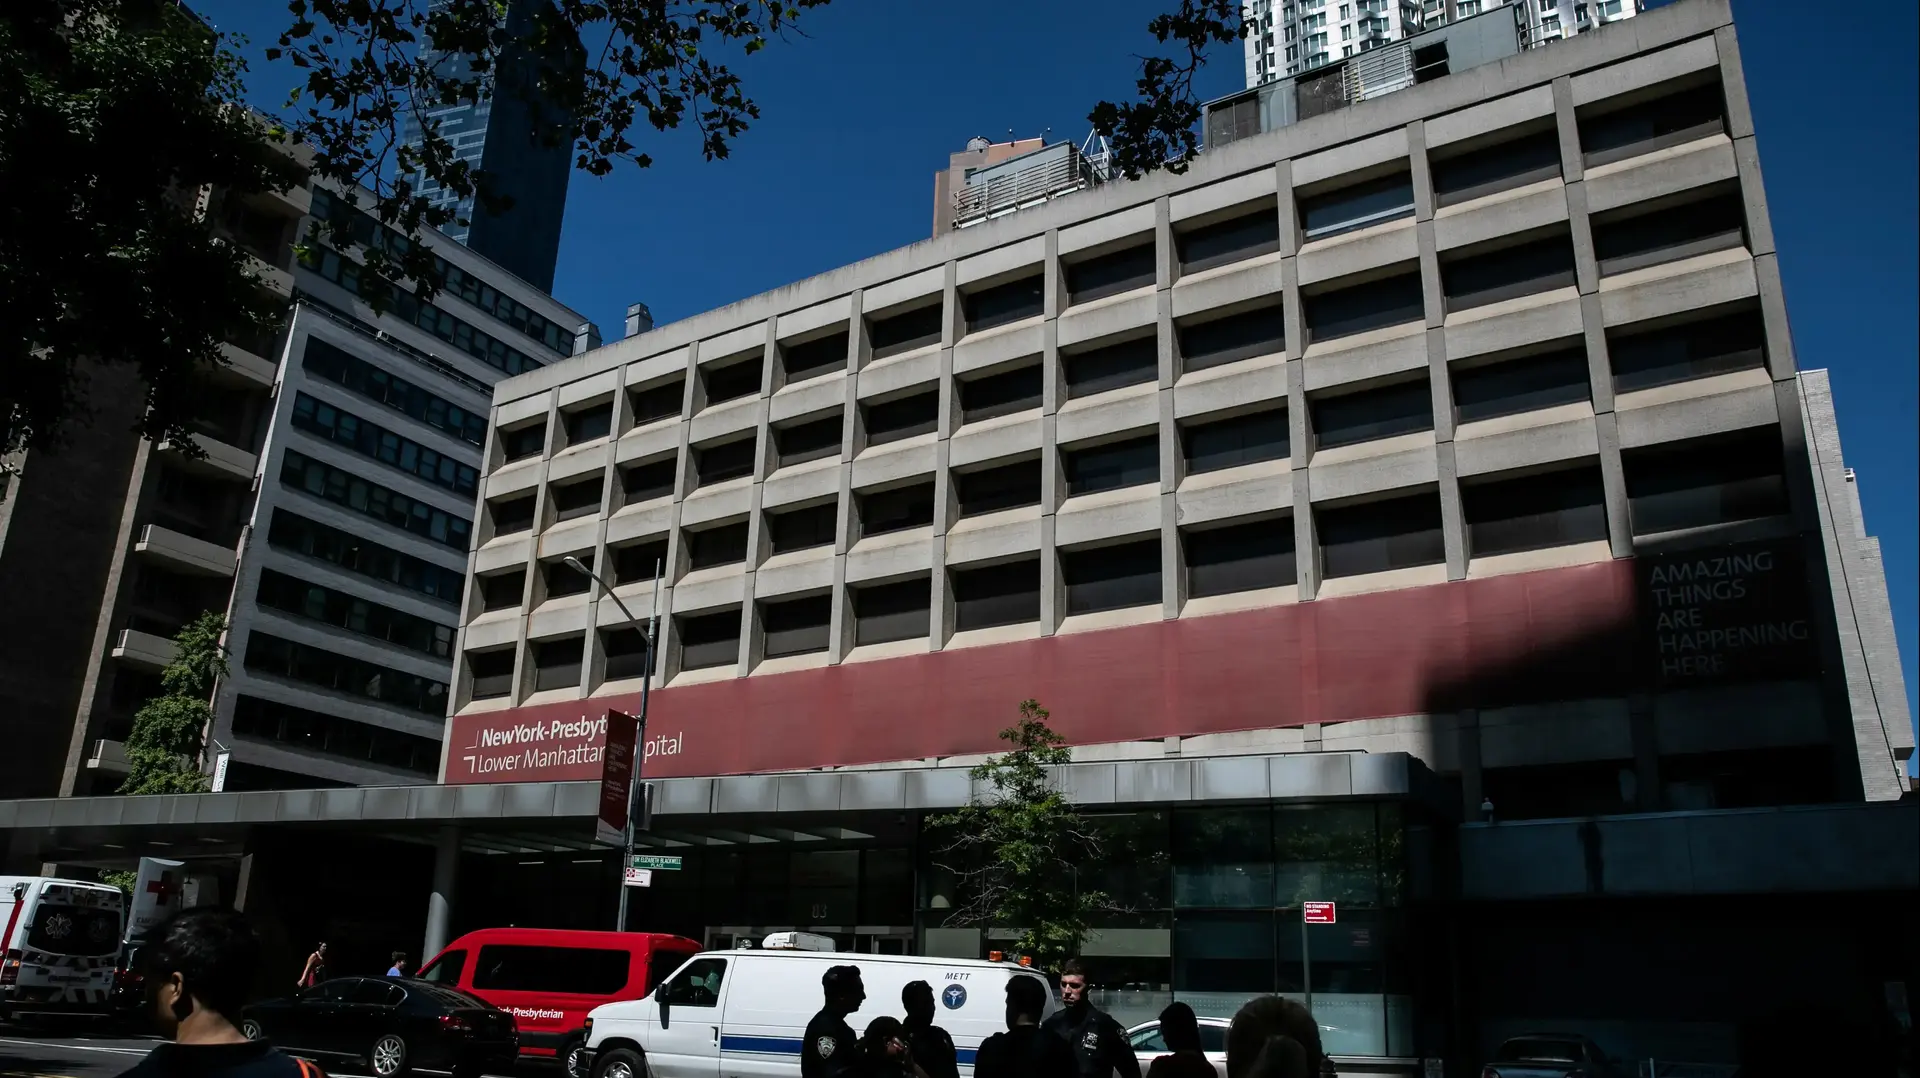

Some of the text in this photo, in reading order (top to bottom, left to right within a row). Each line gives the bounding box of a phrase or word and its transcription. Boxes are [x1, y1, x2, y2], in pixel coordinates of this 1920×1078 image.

[1650, 551, 1773, 585] AMAZING
[1652, 578, 1746, 607] THINGS
[1657, 608, 1702, 631] ARE
[1659, 620, 1809, 653] HAPPENING
[1662, 654, 1724, 677] HERE
[481, 711, 647, 748] NewYork-Presbyt
[478, 754, 520, 773] Lower
[634, 731, 682, 764] pital
[944, 972, 972, 980] METT
